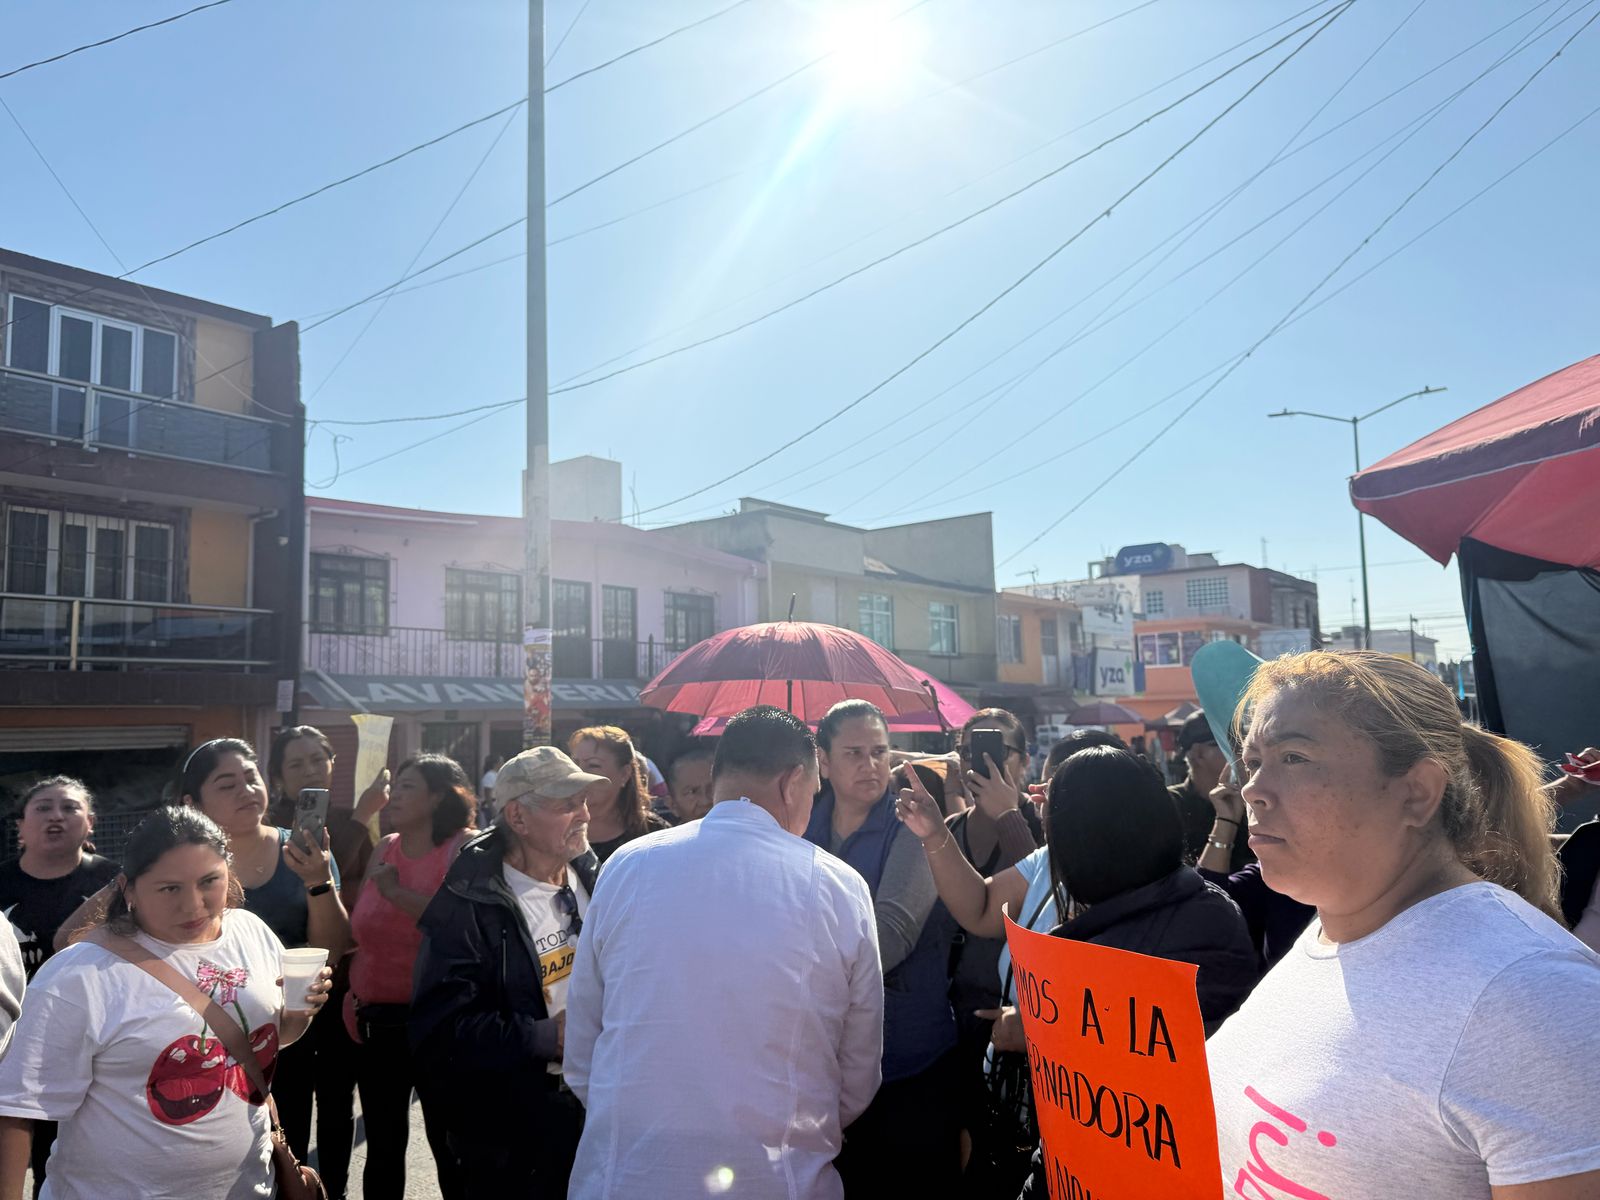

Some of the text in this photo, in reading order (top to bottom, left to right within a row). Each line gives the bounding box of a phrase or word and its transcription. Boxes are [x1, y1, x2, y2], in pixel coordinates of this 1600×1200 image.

[1124, 554, 1153, 568] yza
[1100, 666, 1125, 688] yza
[318, 682, 641, 704] LAVANERI
[1081, 988, 1105, 1045] A
[1128, 997, 1177, 1063] LA
